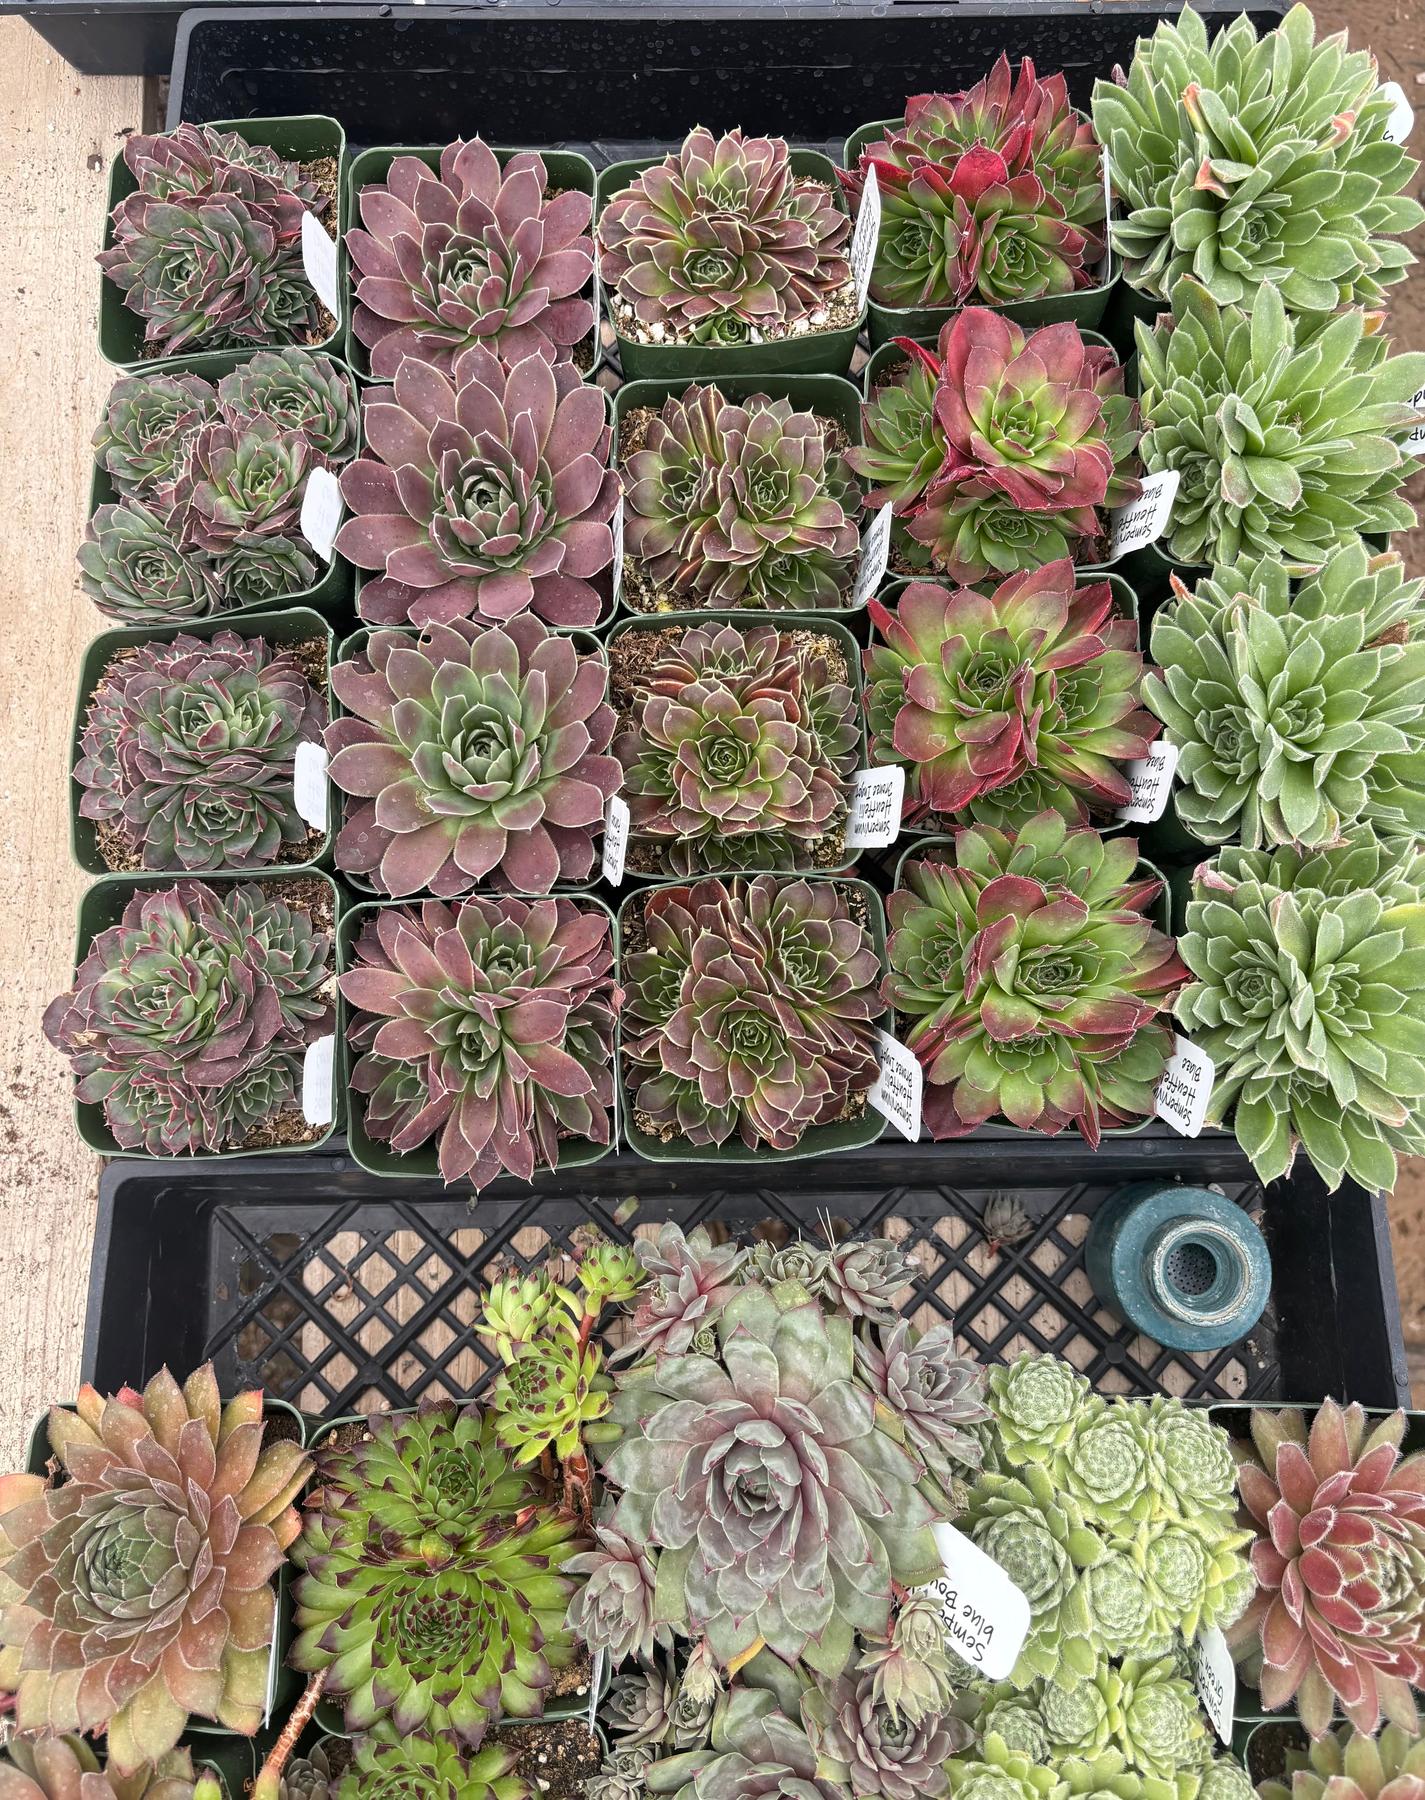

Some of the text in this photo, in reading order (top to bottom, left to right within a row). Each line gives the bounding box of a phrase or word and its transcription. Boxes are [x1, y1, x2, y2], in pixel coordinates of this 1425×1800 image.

[1117, 503, 1158, 531] Heuffe
[1129, 776, 1160, 796] Heuffe
[1180, 1057, 1202, 1082] Blaze
[1159, 1071, 1196, 1106] Heuffel
[936, 1608, 986, 1662] Sempe
[962, 1604, 994, 1645] blue
[1197, 1671, 1222, 1730] Semper
